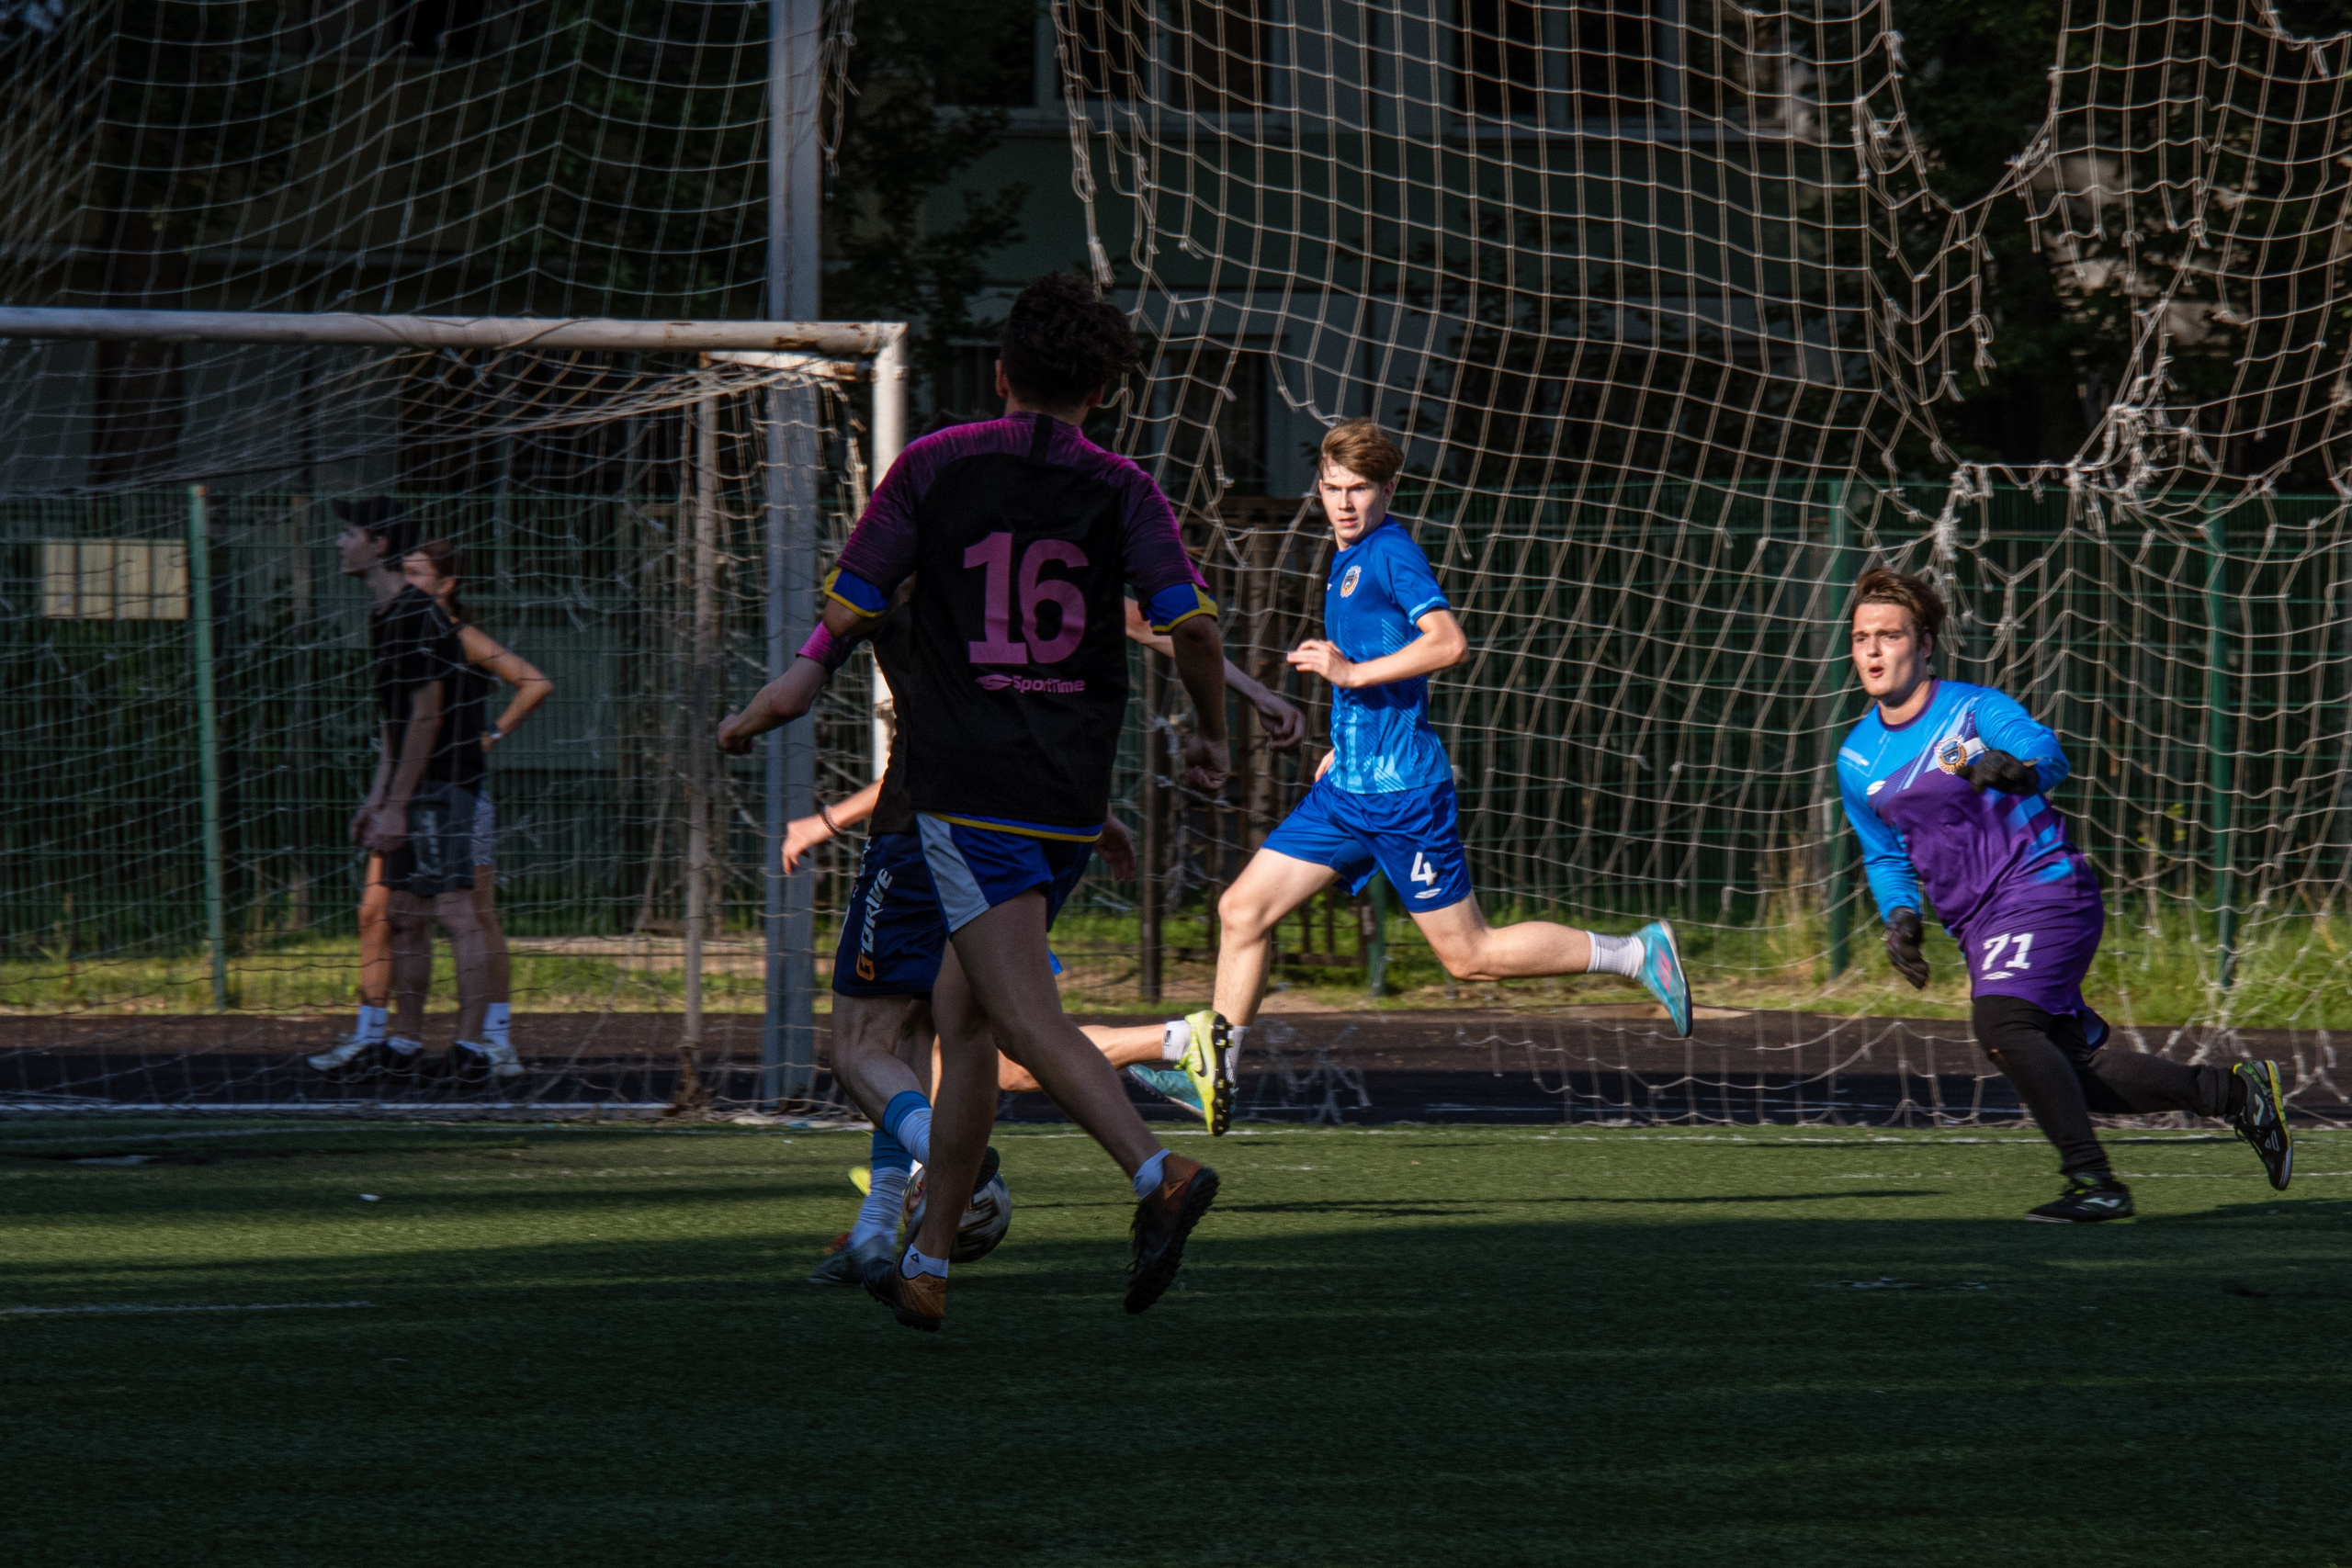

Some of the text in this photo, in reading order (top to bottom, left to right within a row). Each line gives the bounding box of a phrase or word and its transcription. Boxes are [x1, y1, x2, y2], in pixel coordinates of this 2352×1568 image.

[963, 532, 1090, 664] 16
[1410, 852, 1438, 886] 4
[1981, 933, 2034, 971] 71
